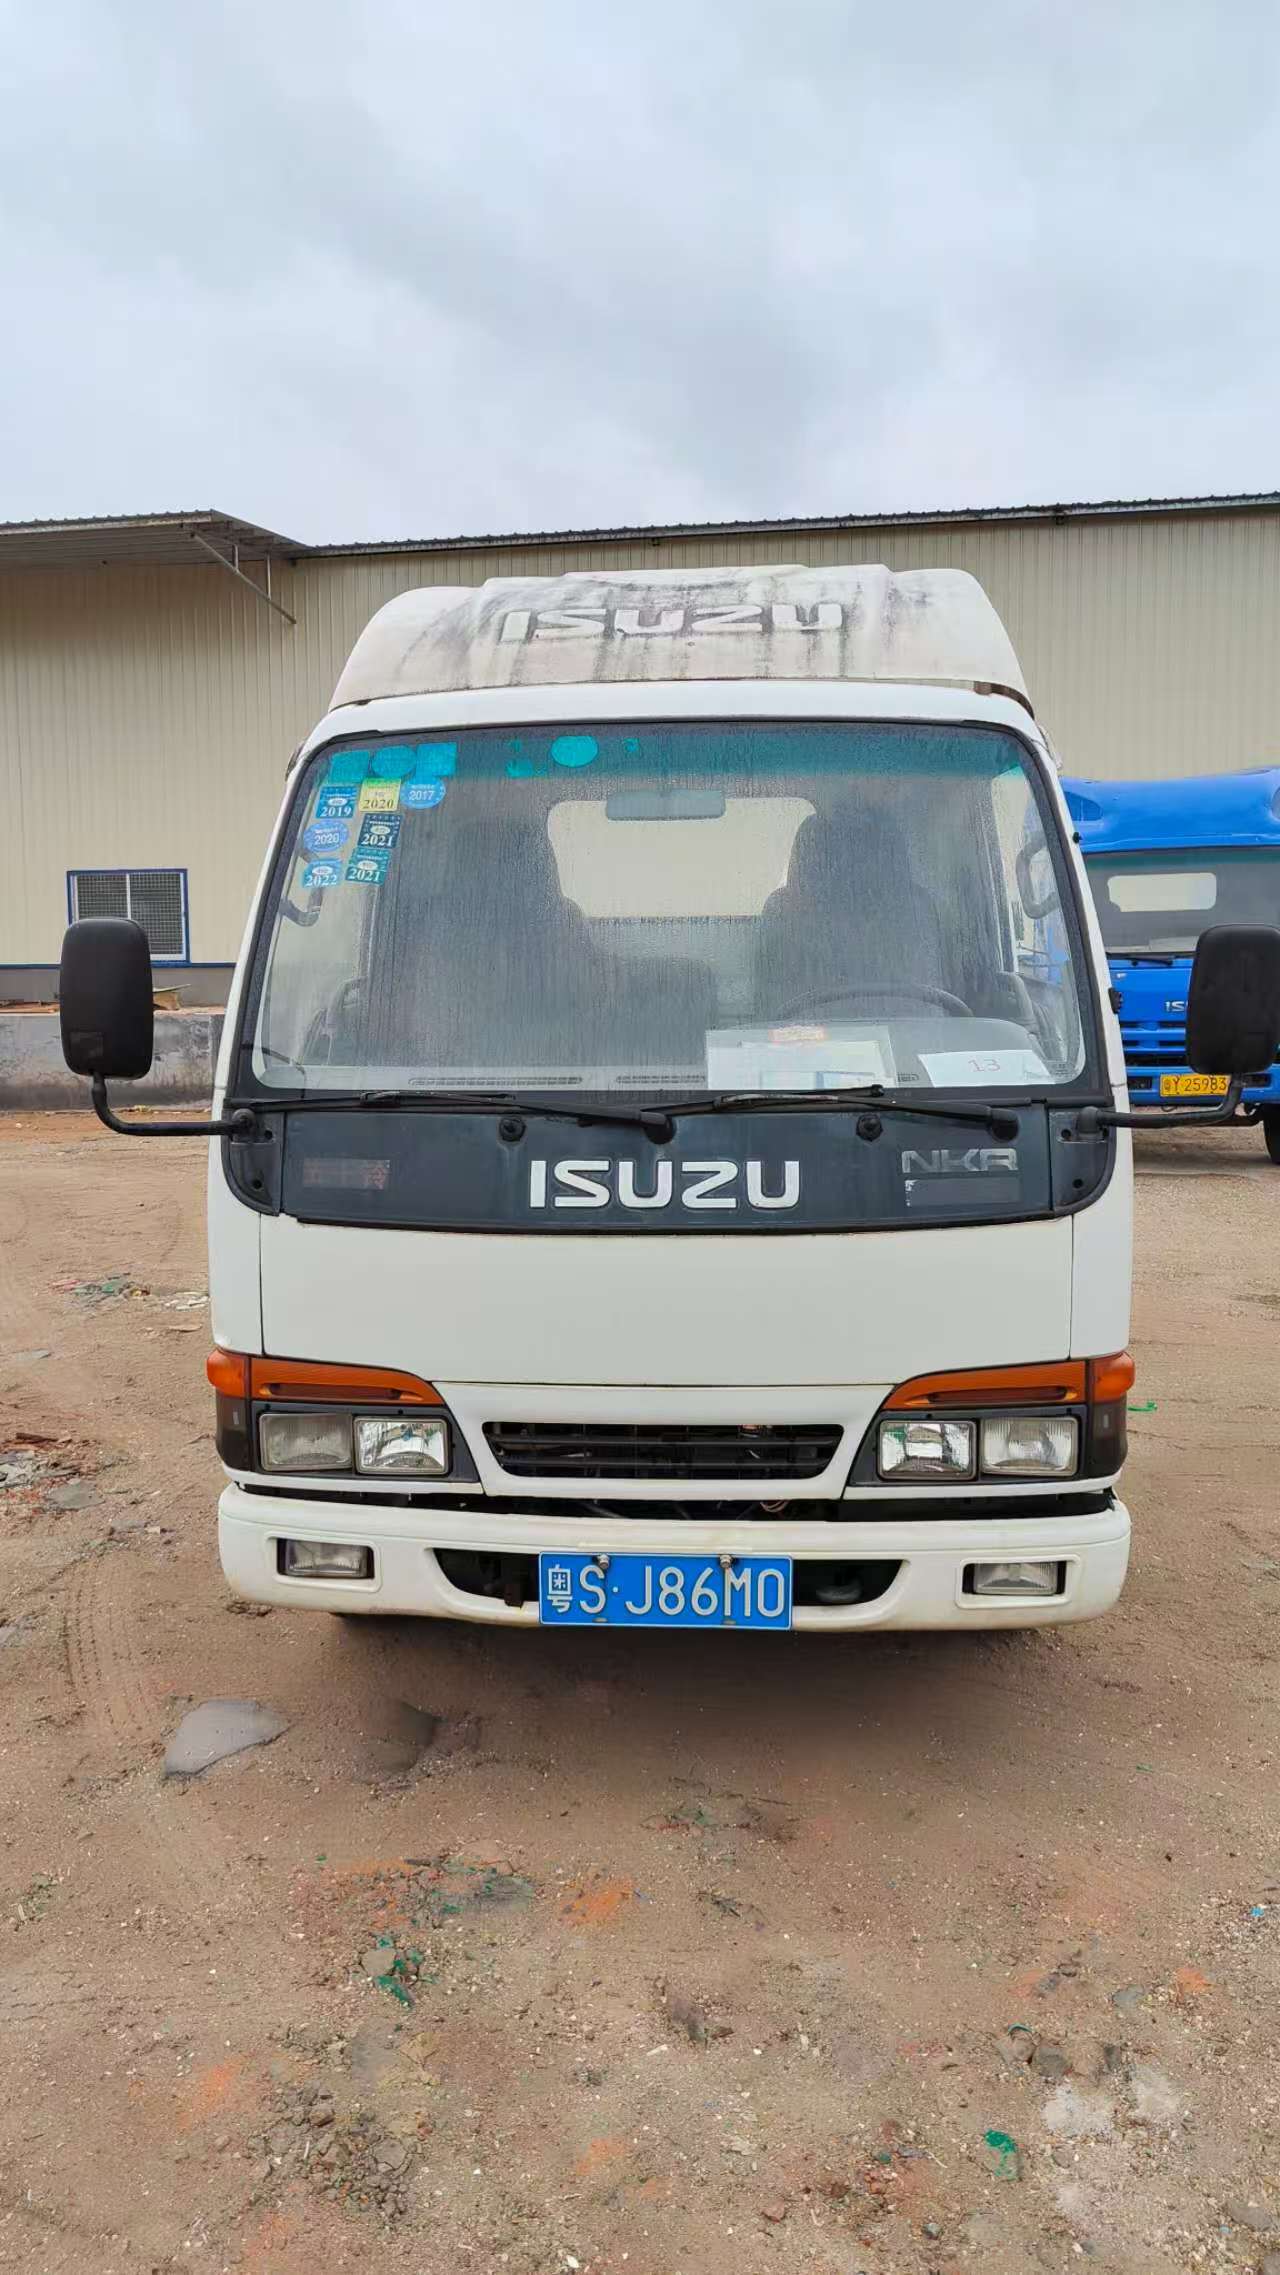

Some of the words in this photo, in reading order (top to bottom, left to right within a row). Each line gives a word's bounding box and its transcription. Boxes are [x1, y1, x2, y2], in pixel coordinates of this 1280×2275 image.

[501, 602, 844, 641] ISUZU
[408, 790, 435, 800] 2017
[362, 799, 395, 809] 2020
[319, 806, 352, 817] 2019
[361, 833, 393, 847] 2021
[305, 874, 337, 887] 2022
[347, 868, 381, 882] 2021
[1166, 1001, 1188, 1012] IS
[967, 1058, 1001, 1072] 13
[901, 1148, 1018, 1173] NKR
[529, 1160, 800, 1208] ISUZU
